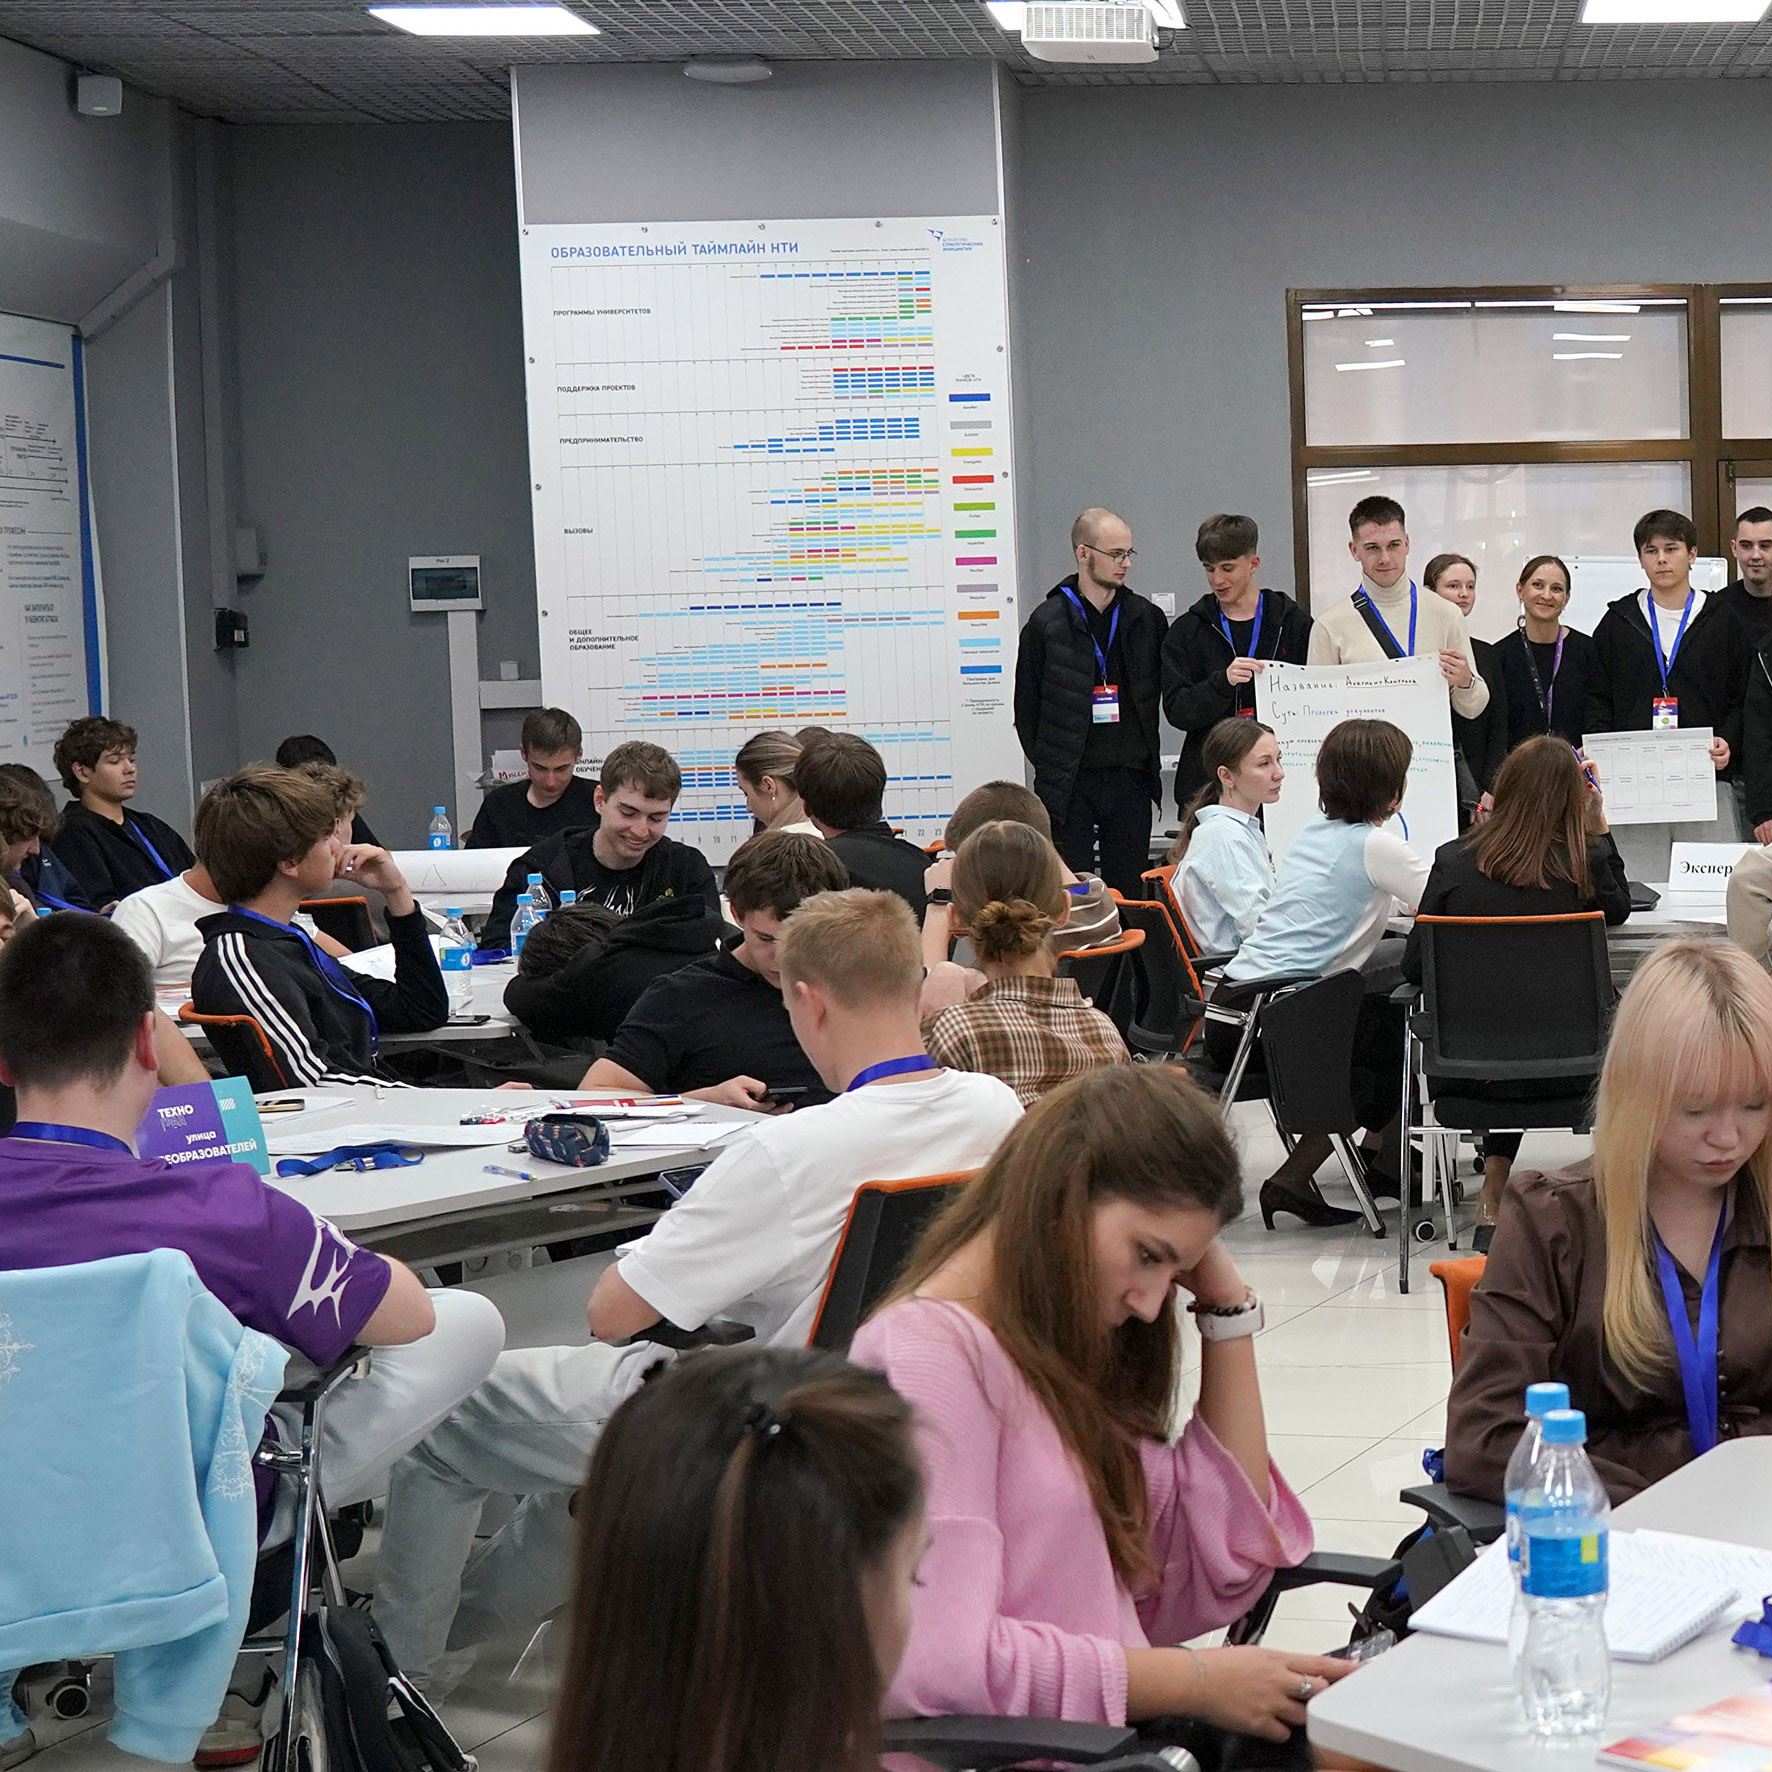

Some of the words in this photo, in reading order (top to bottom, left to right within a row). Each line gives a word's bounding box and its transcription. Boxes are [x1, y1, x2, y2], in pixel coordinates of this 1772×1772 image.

[551, 241, 687, 259] ОБРАЗОВАТЕЛЬНЫЙ
[691, 240, 766, 256] ТАЙМЛАЙН
[771, 242, 799, 254] НТИ
[553, 309, 595, 317] ПРОГРАММЫ
[596, 308, 651, 316] УНИВЕРСИТЕТОВ
[557, 385, 600, 393] ПОДДЕРЖКА
[559, 436, 644, 445] ПРЕДПРИНИМАТЕЛЬСТВО
[563, 526, 594, 535] ВЫЗОВЫ
[576, 635, 639, 644] ДОПОЛНИТЕЛЬНОЕ
[569, 643, 616, 651] ОБРАЗОВАНИЕ
[1269, 674, 1338, 693] Название:
[498, 770, 530, 780] Мисси
[713, 835, 721, 843] 10
[730, 835, 737, 843] 11
[934, 828, 942, 836] 23
[1680, 860, 1735, 877] Экспер
[157, 1104, 194, 1119] ТЕХНО
[185, 1131, 217, 1145] улица
[160, 1139, 257, 1165] ЕОБРАЗОВАТЕЛЕЙ
